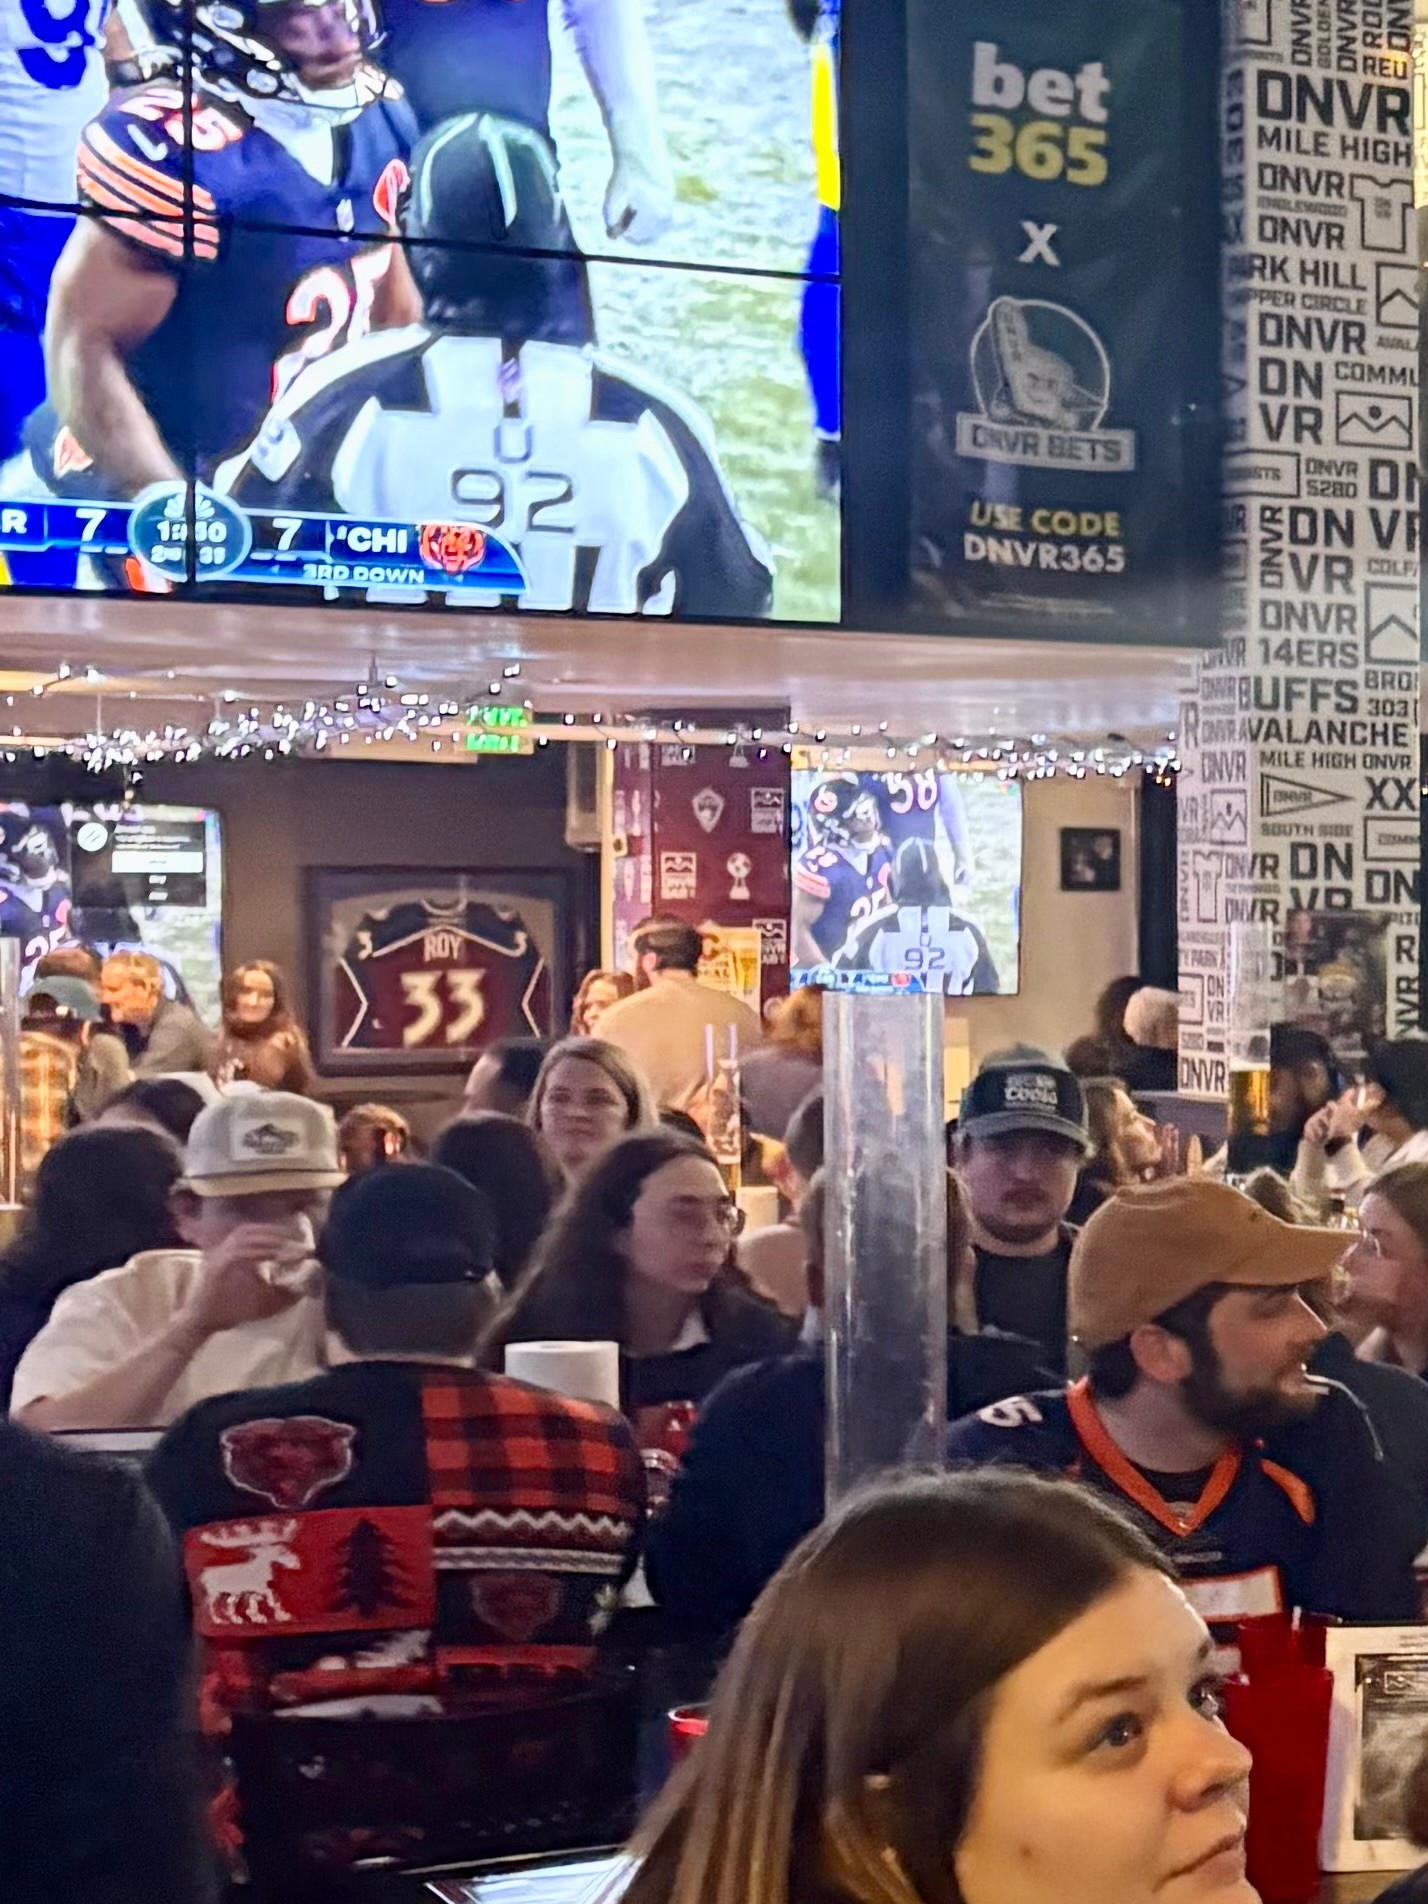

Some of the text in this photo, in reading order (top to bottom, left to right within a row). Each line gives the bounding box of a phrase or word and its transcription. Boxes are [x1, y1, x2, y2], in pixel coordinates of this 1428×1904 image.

[971, 41, 1111, 124] bet
[1363, 52, 1408, 79] RED
[1258, 70, 1410, 136] DNVR
[969, 113, 1108, 186] 365
[1258, 126, 1331, 158] MILE
[1340, 138, 1411, 168] HIGH
[1258, 163, 1344, 198] DNVR
[1259, 214, 1344, 250] DNVR
[1259, 312, 1366, 354] DNVR
[971, 422, 1122, 464] DNVR BETS
[449, 468, 575, 533] 92
[1306, 479, 1356, 499] 5280
[75, 509, 108, 542] 7
[272, 517, 304, 551] 7
[969, 500, 1120, 538] USE CODE
[964, 533, 1124, 573] DNVR365
[1260, 505, 1283, 588] DNVR
[353, 567, 425, 584] DOWN
[1260, 599, 1356, 634] DNVR
[1260, 639, 1358, 668] 14ERS
[1367, 700, 1408, 717] 303
[1240, 720, 1408, 747] AVALANCHE
[1260, 752, 1411, 770] MILE HIGH DNVR
[424, 935, 464, 962] ROY
[904, 948, 946, 971] 92
[401, 968, 486, 1048] 33
